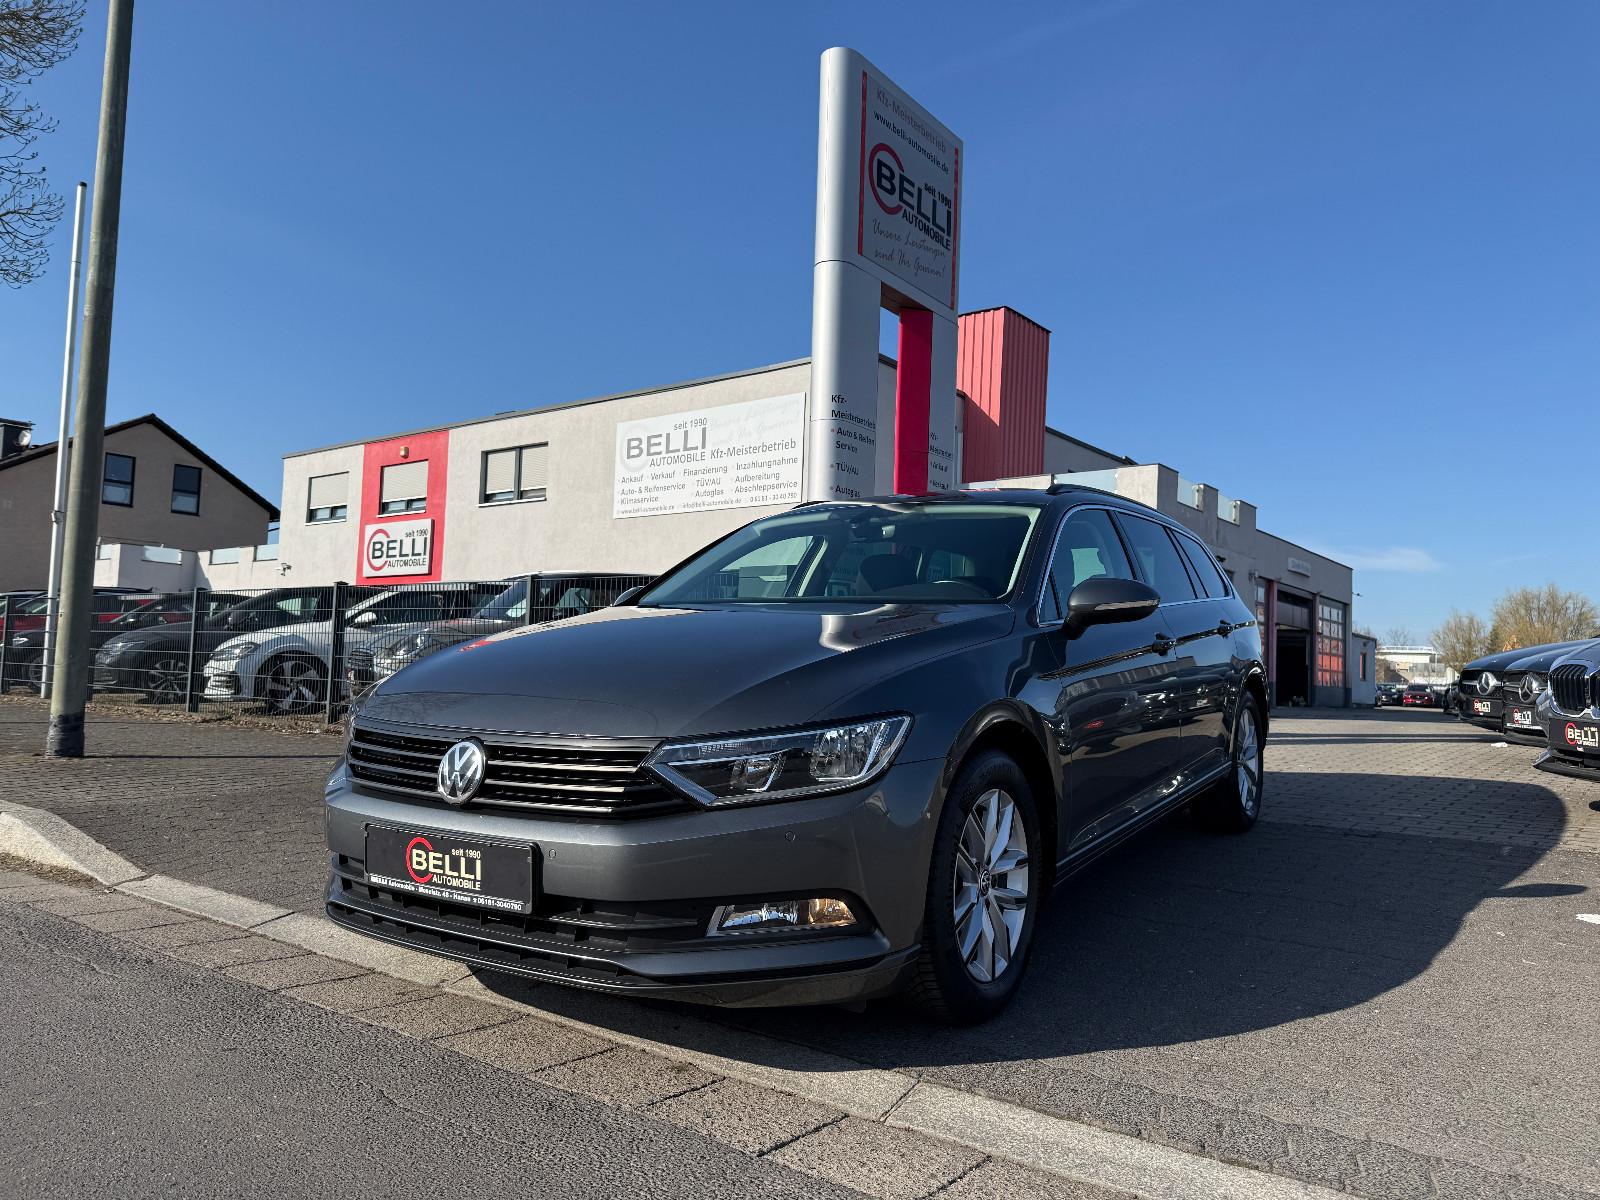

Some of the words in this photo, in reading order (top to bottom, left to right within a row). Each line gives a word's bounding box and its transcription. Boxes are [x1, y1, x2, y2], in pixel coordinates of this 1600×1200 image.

[877, 87, 946, 153] Kfz-Meisterbetrieb
[877, 158, 952, 238] BELLI
[923, 182, 937, 199] seit
[937, 191, 952, 210] 1990
[902, 208, 951, 251] AUTOMOBILE
[831, 394, 848, 404] Kfz-
[673, 420, 688, 430] seit
[690, 417, 708, 428] 1990
[836, 427, 852, 438] Auto
[626, 427, 707, 460] BELLI
[710, 437, 797, 460] Kfz-Meisterbetrieb
[650, 451, 706, 467] AUTOMOBILE
[621, 474, 644, 484] Ankauf
[650, 470, 676, 480] Verkauf
[683, 466, 728, 477] Finanzierung
[736, 456, 798, 471] Inzahlungnahme
[735, 472, 780, 483] Aufbereitung
[695, 488, 724, 498] Autoglas
[735, 481, 798, 494] Abschleppservice
[405, 529, 415, 538] seit
[416, 528, 429, 537] 1990
[372, 537, 428, 560] BELLI
[387, 558, 427, 568] AUTOMOBILE
[1567, 728, 1599, 744] BELLI
[451, 848, 464, 857] seit
[465, 849, 481, 859] 1990
[411, 848, 481, 880] BELLI
[432, 874, 481, 891] AUTOMOBILE
